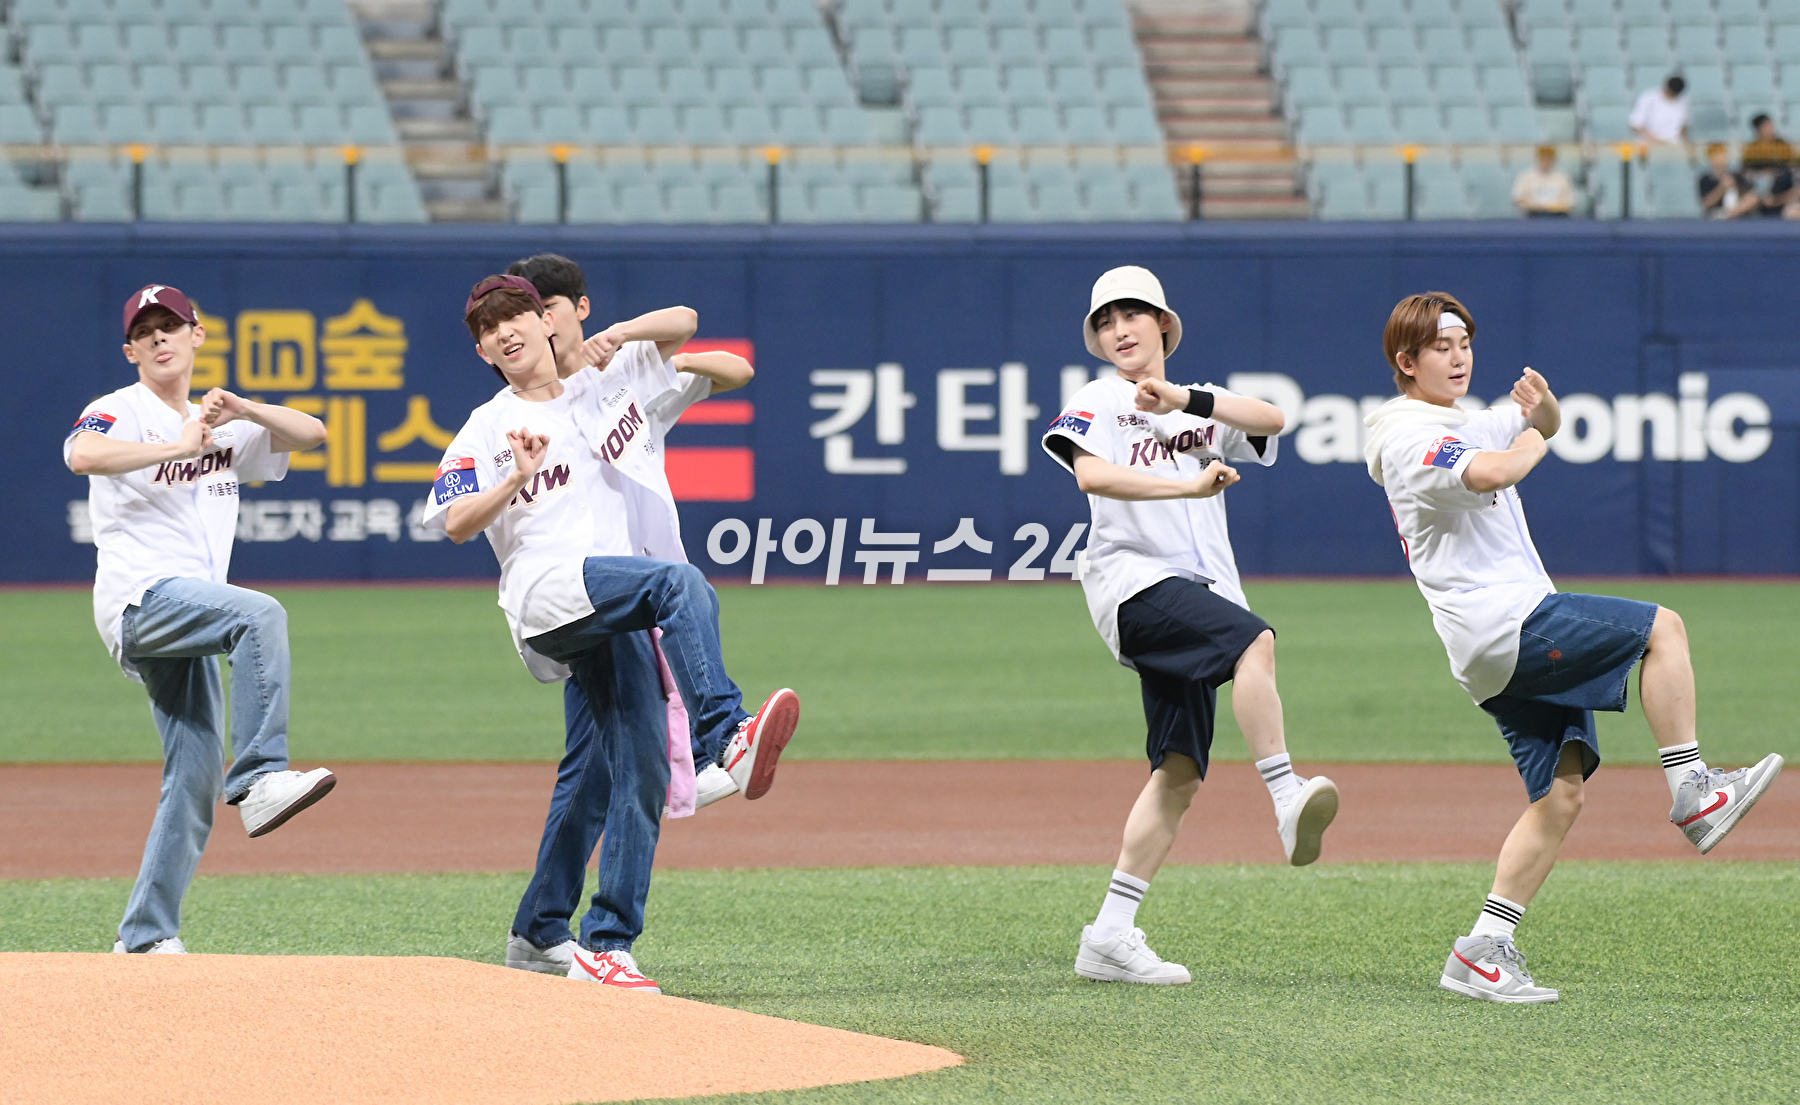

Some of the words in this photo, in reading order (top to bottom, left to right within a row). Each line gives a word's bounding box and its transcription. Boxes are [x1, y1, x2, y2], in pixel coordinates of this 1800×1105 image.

[138, 286, 165, 308] K
[1227, 371, 1773, 464] Paonic
[1129, 424, 1215, 467] KIWOOM
[441, 459, 462, 474] SGC
[438, 487, 455, 503] THE
[454, 483, 474, 495] LIV
